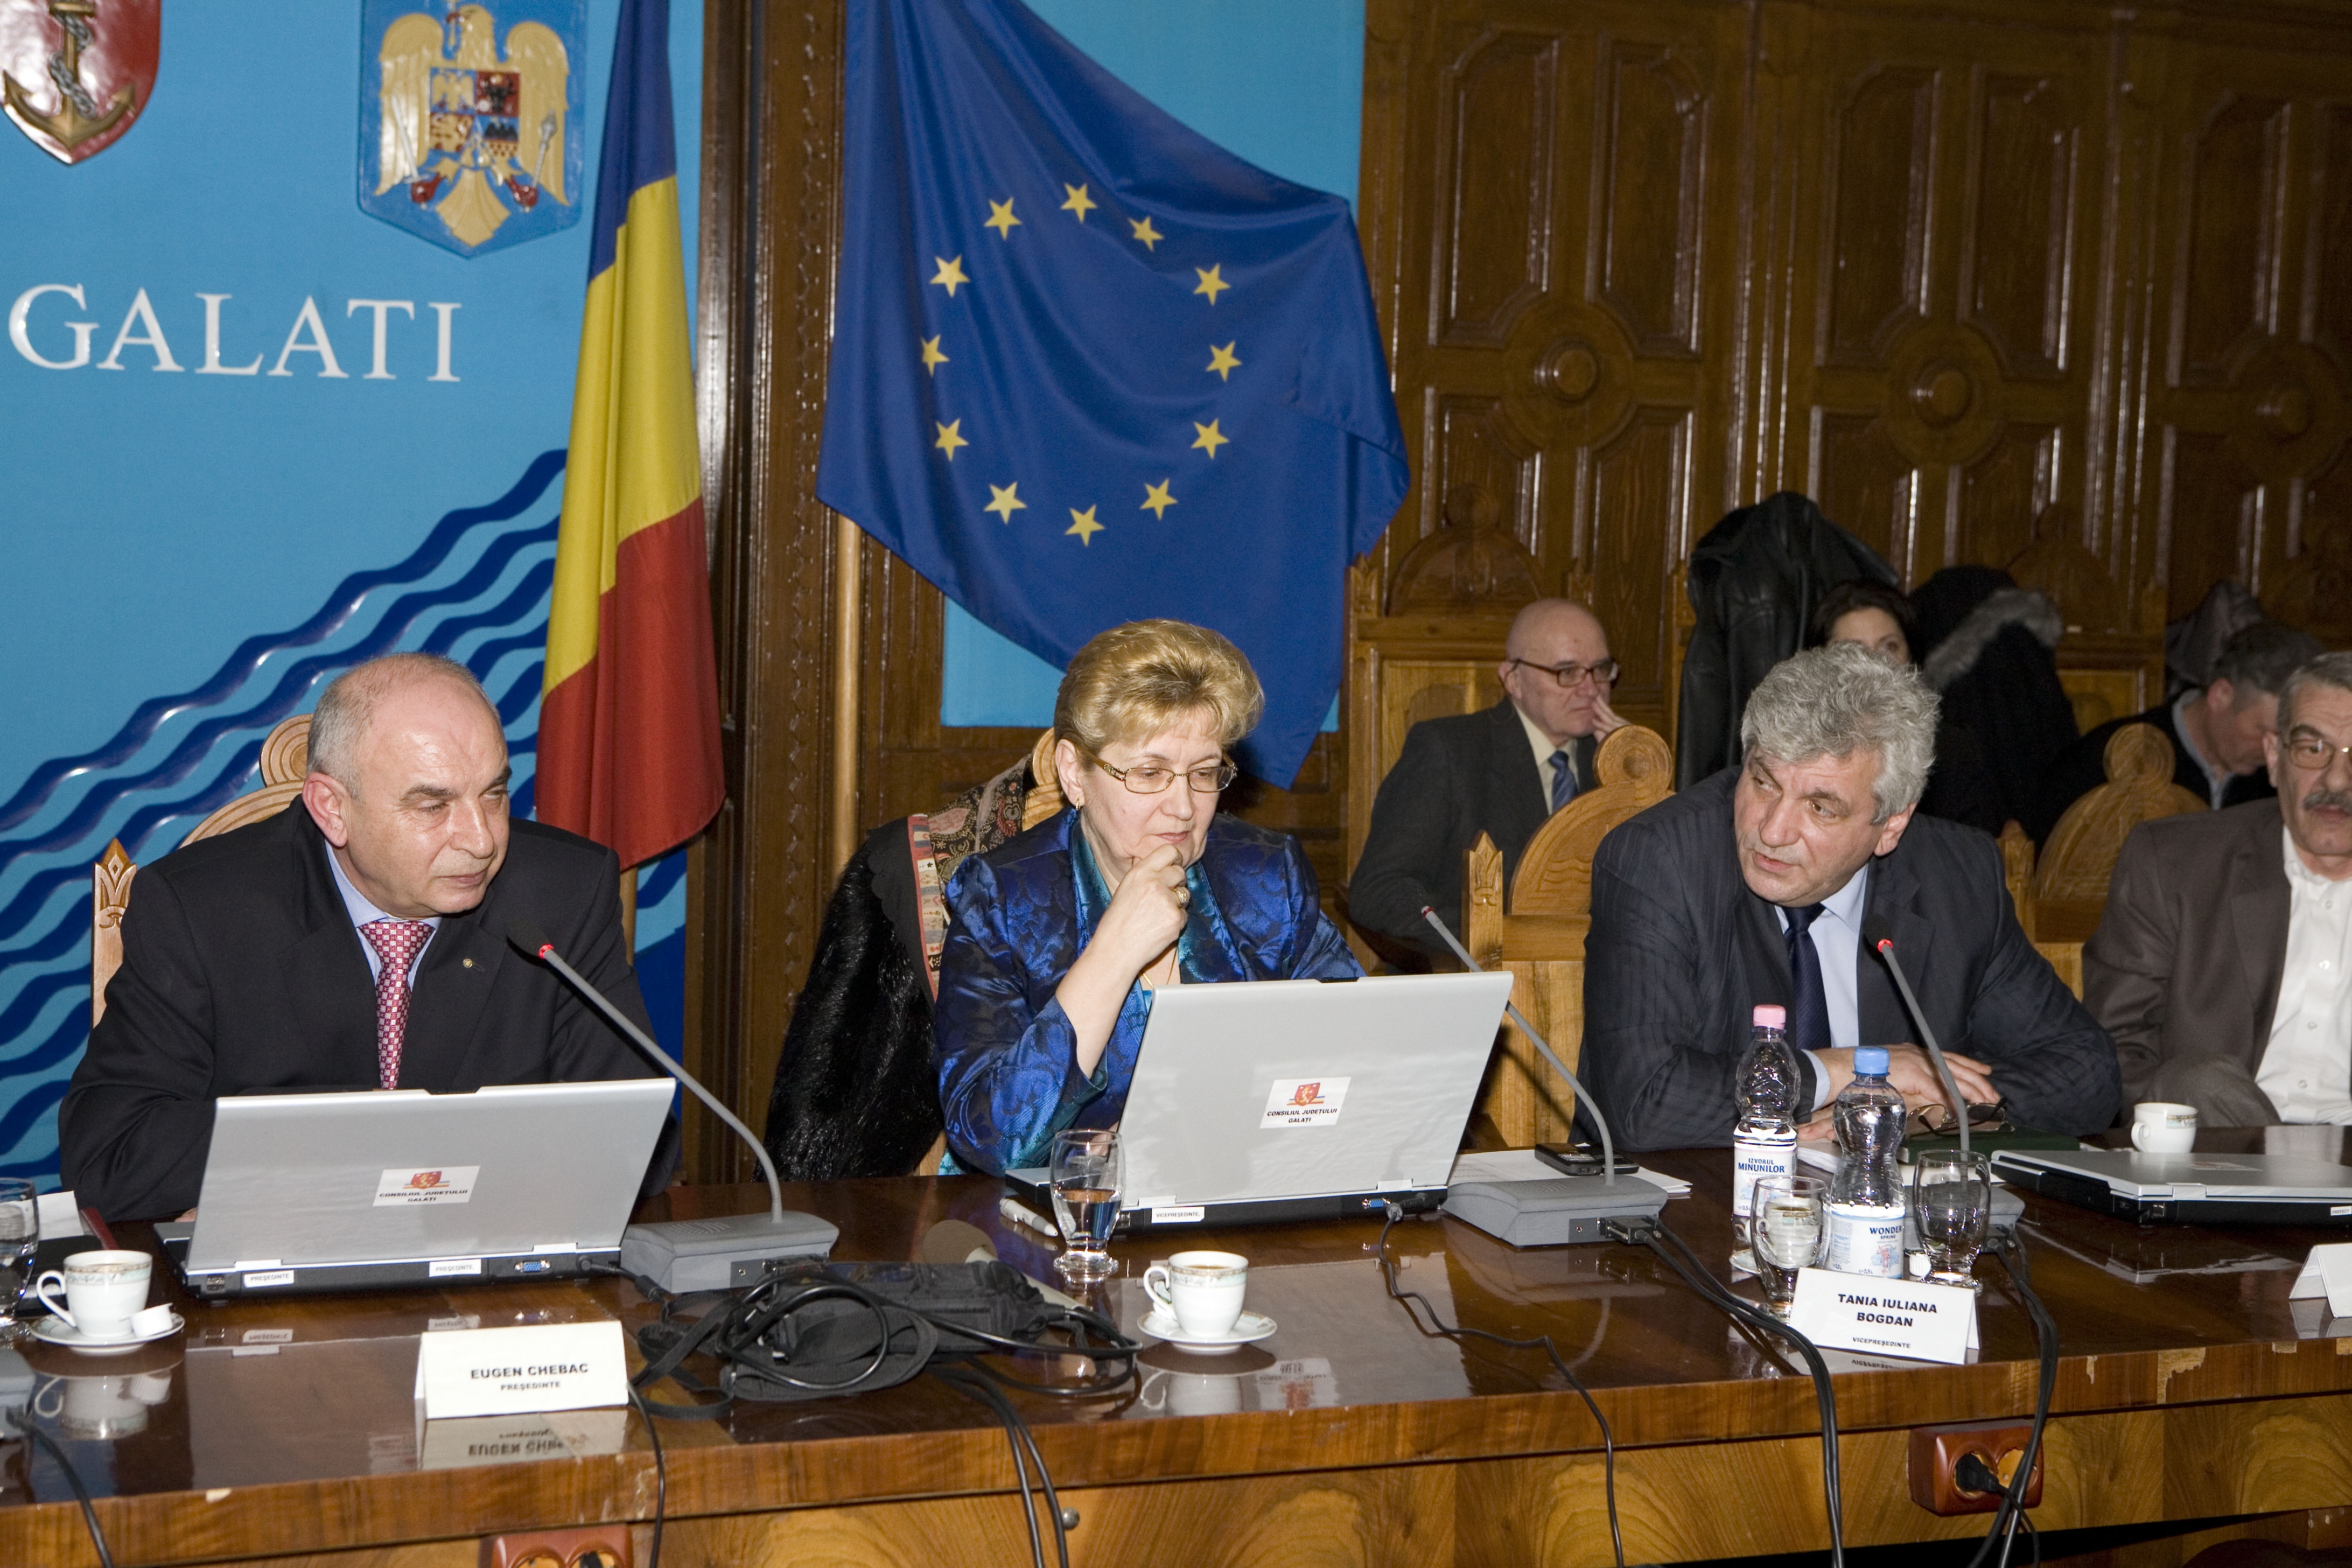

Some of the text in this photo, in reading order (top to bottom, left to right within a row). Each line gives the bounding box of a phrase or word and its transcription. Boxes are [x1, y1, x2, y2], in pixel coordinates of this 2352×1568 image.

[8, 283, 462, 382] GALATI
[1738, 1162, 1785, 1173] MINUNILOR
[1870, 1225, 1902, 1234] WONDER
[1838, 1294, 1937, 1314] TANIA IULIANA
[1857, 1312, 1913, 1327] BOGDAN
[471, 1363, 589, 1379] EUGEN CHEBAC
